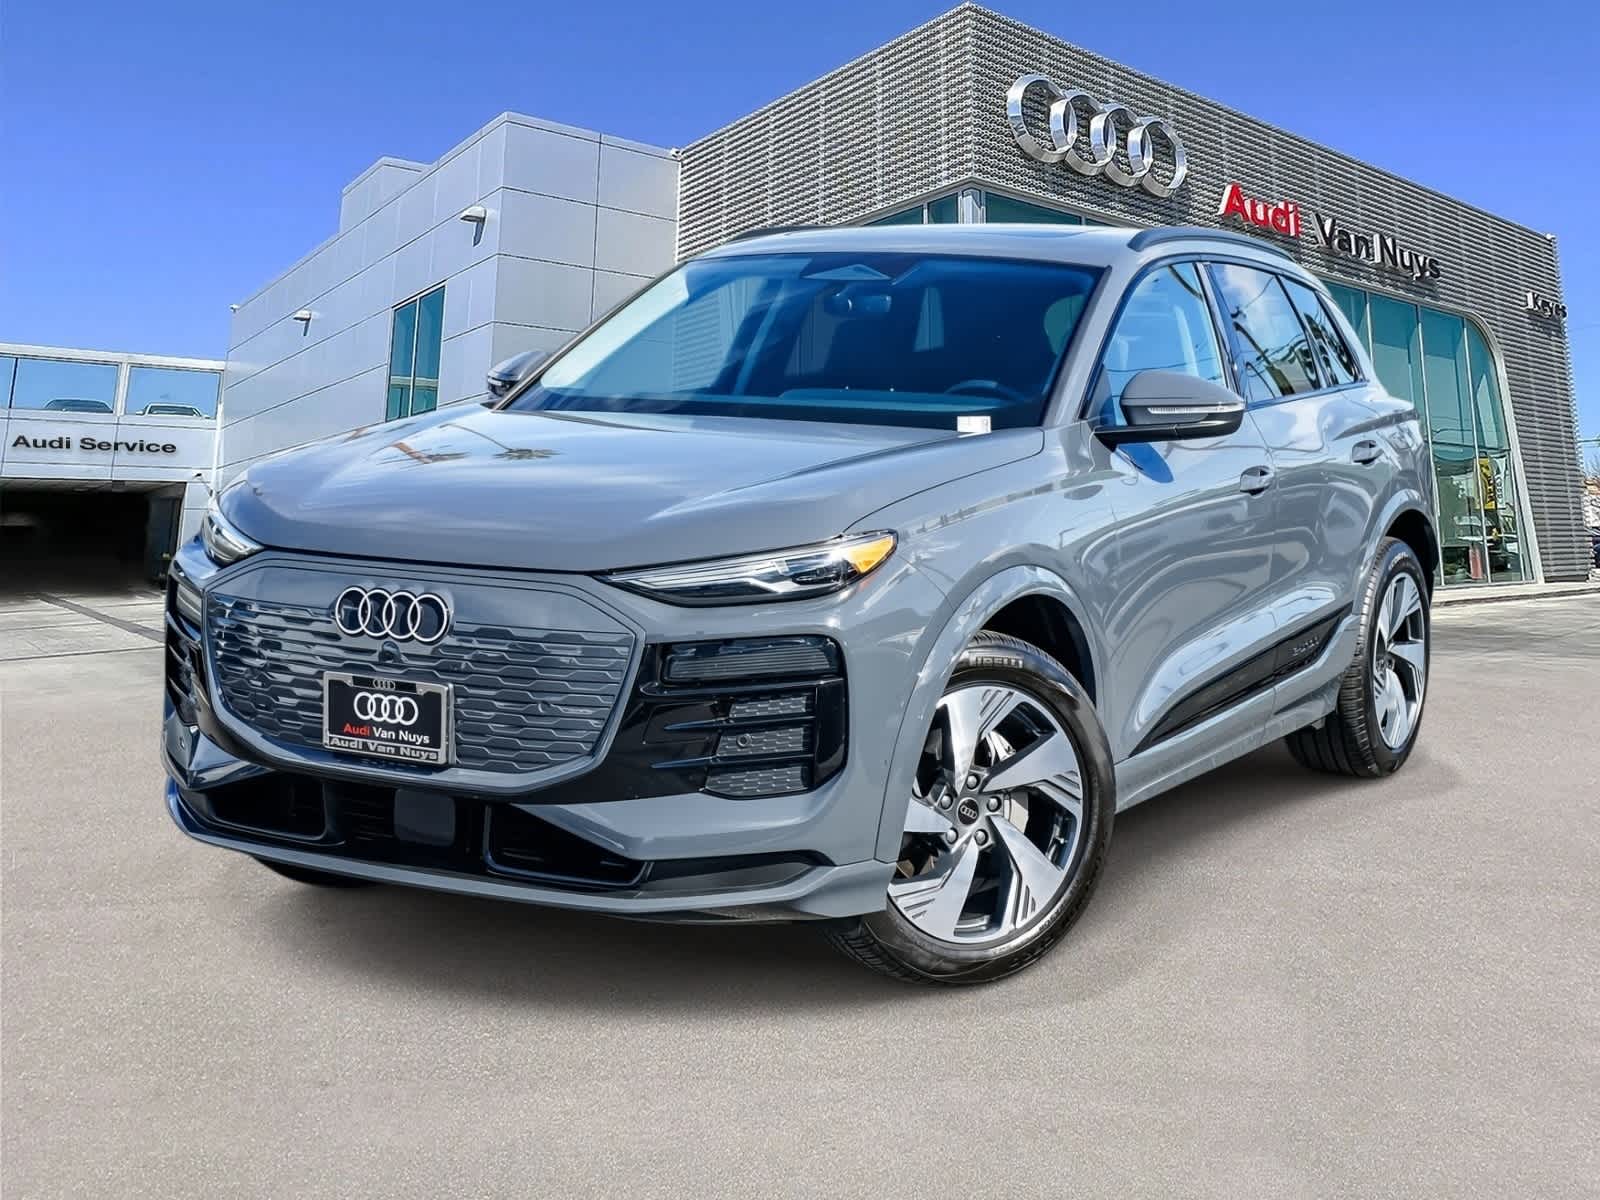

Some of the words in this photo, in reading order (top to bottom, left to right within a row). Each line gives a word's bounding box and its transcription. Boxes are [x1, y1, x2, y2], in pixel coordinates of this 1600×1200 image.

[1219, 182, 1301, 237] Audi
[1311, 212, 1373, 261] Van
[1373, 232, 1441, 281] Nuys
[1526, 291, 1568, 319] Keyes
[12, 435, 71, 449] Audi
[79, 437, 177, 454] Service
[343, 723, 370, 737] Audi
[372, 726, 396, 740] Van
[398, 730, 430, 745] Nuys
[329, 737, 363, 750] Audi
[367, 742, 396, 755] Van
[400, 746, 438, 761] Nuys
